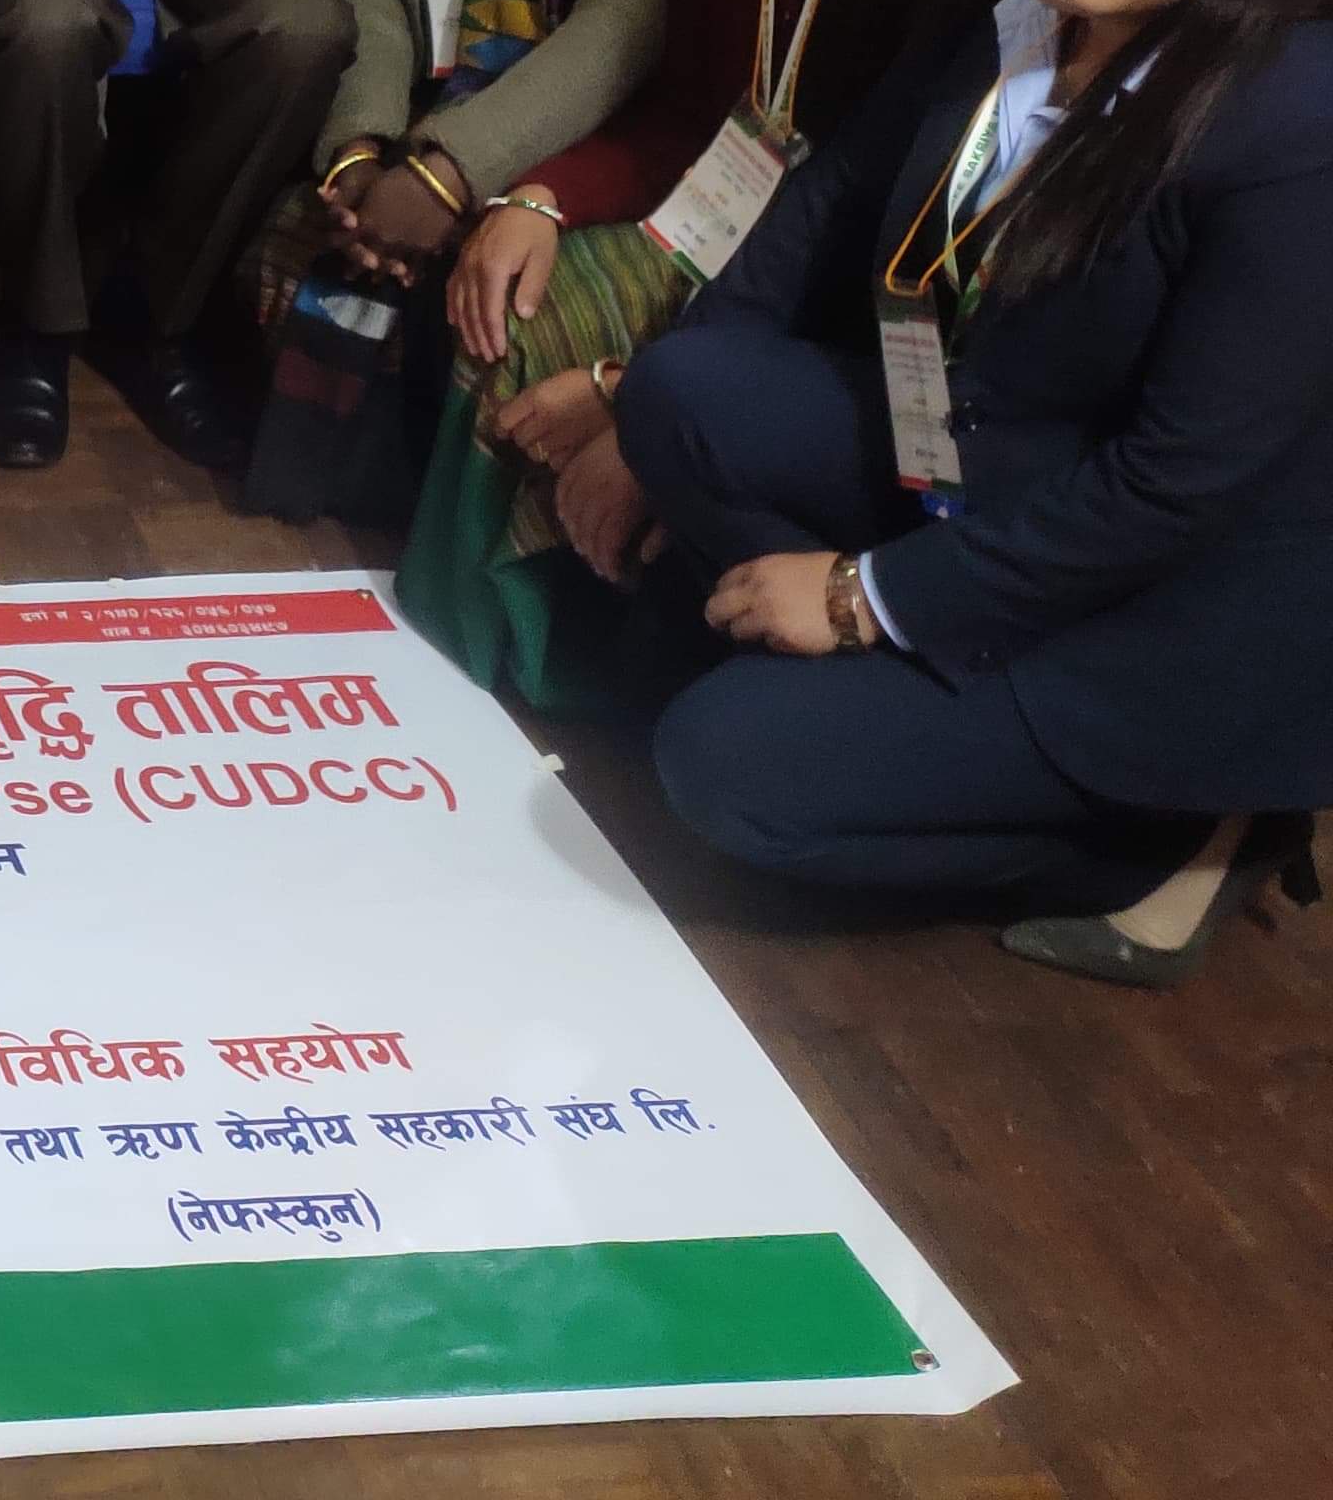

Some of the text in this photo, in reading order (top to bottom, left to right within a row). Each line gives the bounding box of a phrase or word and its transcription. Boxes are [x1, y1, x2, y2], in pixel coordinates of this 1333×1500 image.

[101, 660, 400, 739] तालिम
[115, 758, 455, 820] (CUDCC)
[209, 1022, 413, 1084] सहयोग
[97, 1122, 203, 1160] ऋण
[215, 1105, 358, 1156] केन्द्रीय
[367, 1096, 536, 1150] सहकारी
[545, 1095, 625, 1142] संघ
[632, 1087, 717, 1136] लि.
